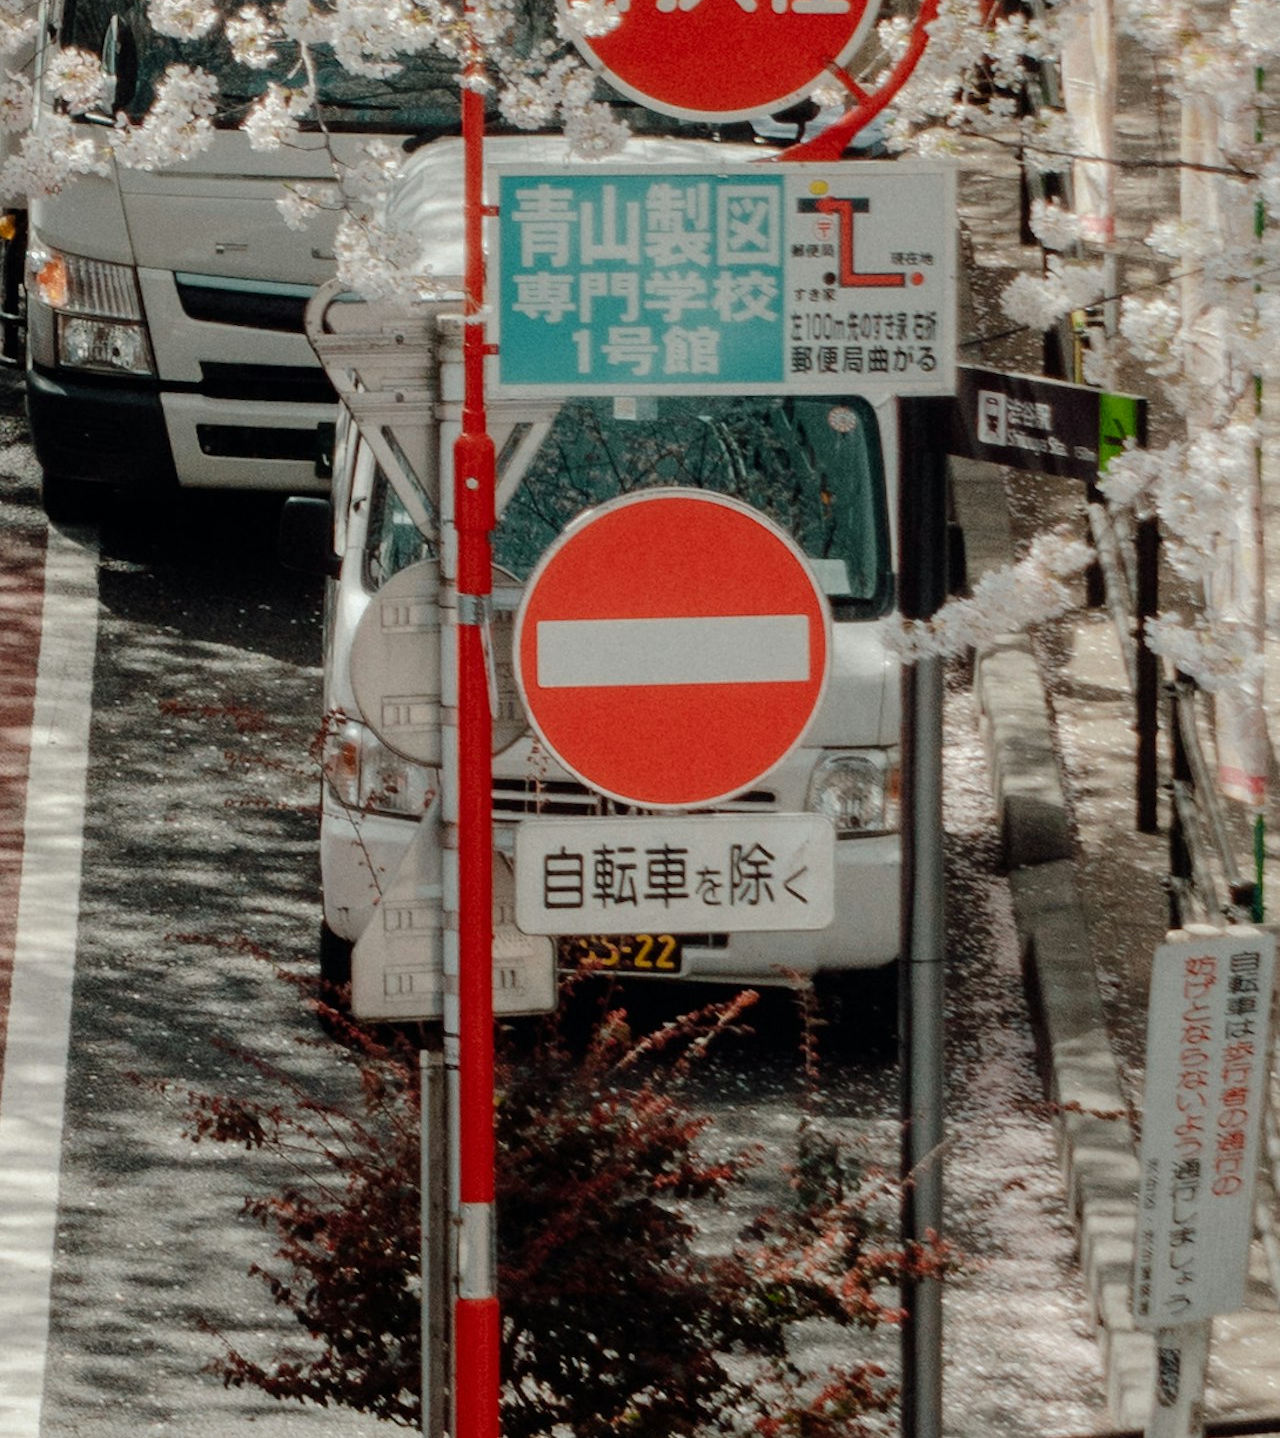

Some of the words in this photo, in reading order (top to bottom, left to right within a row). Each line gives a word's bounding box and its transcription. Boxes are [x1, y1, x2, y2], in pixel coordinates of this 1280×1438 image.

[511, 183, 781, 268] 青山製図
[791, 243, 834, 258] 郵便局
[890, 251, 934, 266] 現在地
[511, 270, 779, 324] 専門学校
[793, 288, 836, 302] すき家
[572, 325, 721, 376] 1号館
[790, 345, 937, 374] 郵便局曲がる
[544, 843, 809, 909] 自転車を除く
